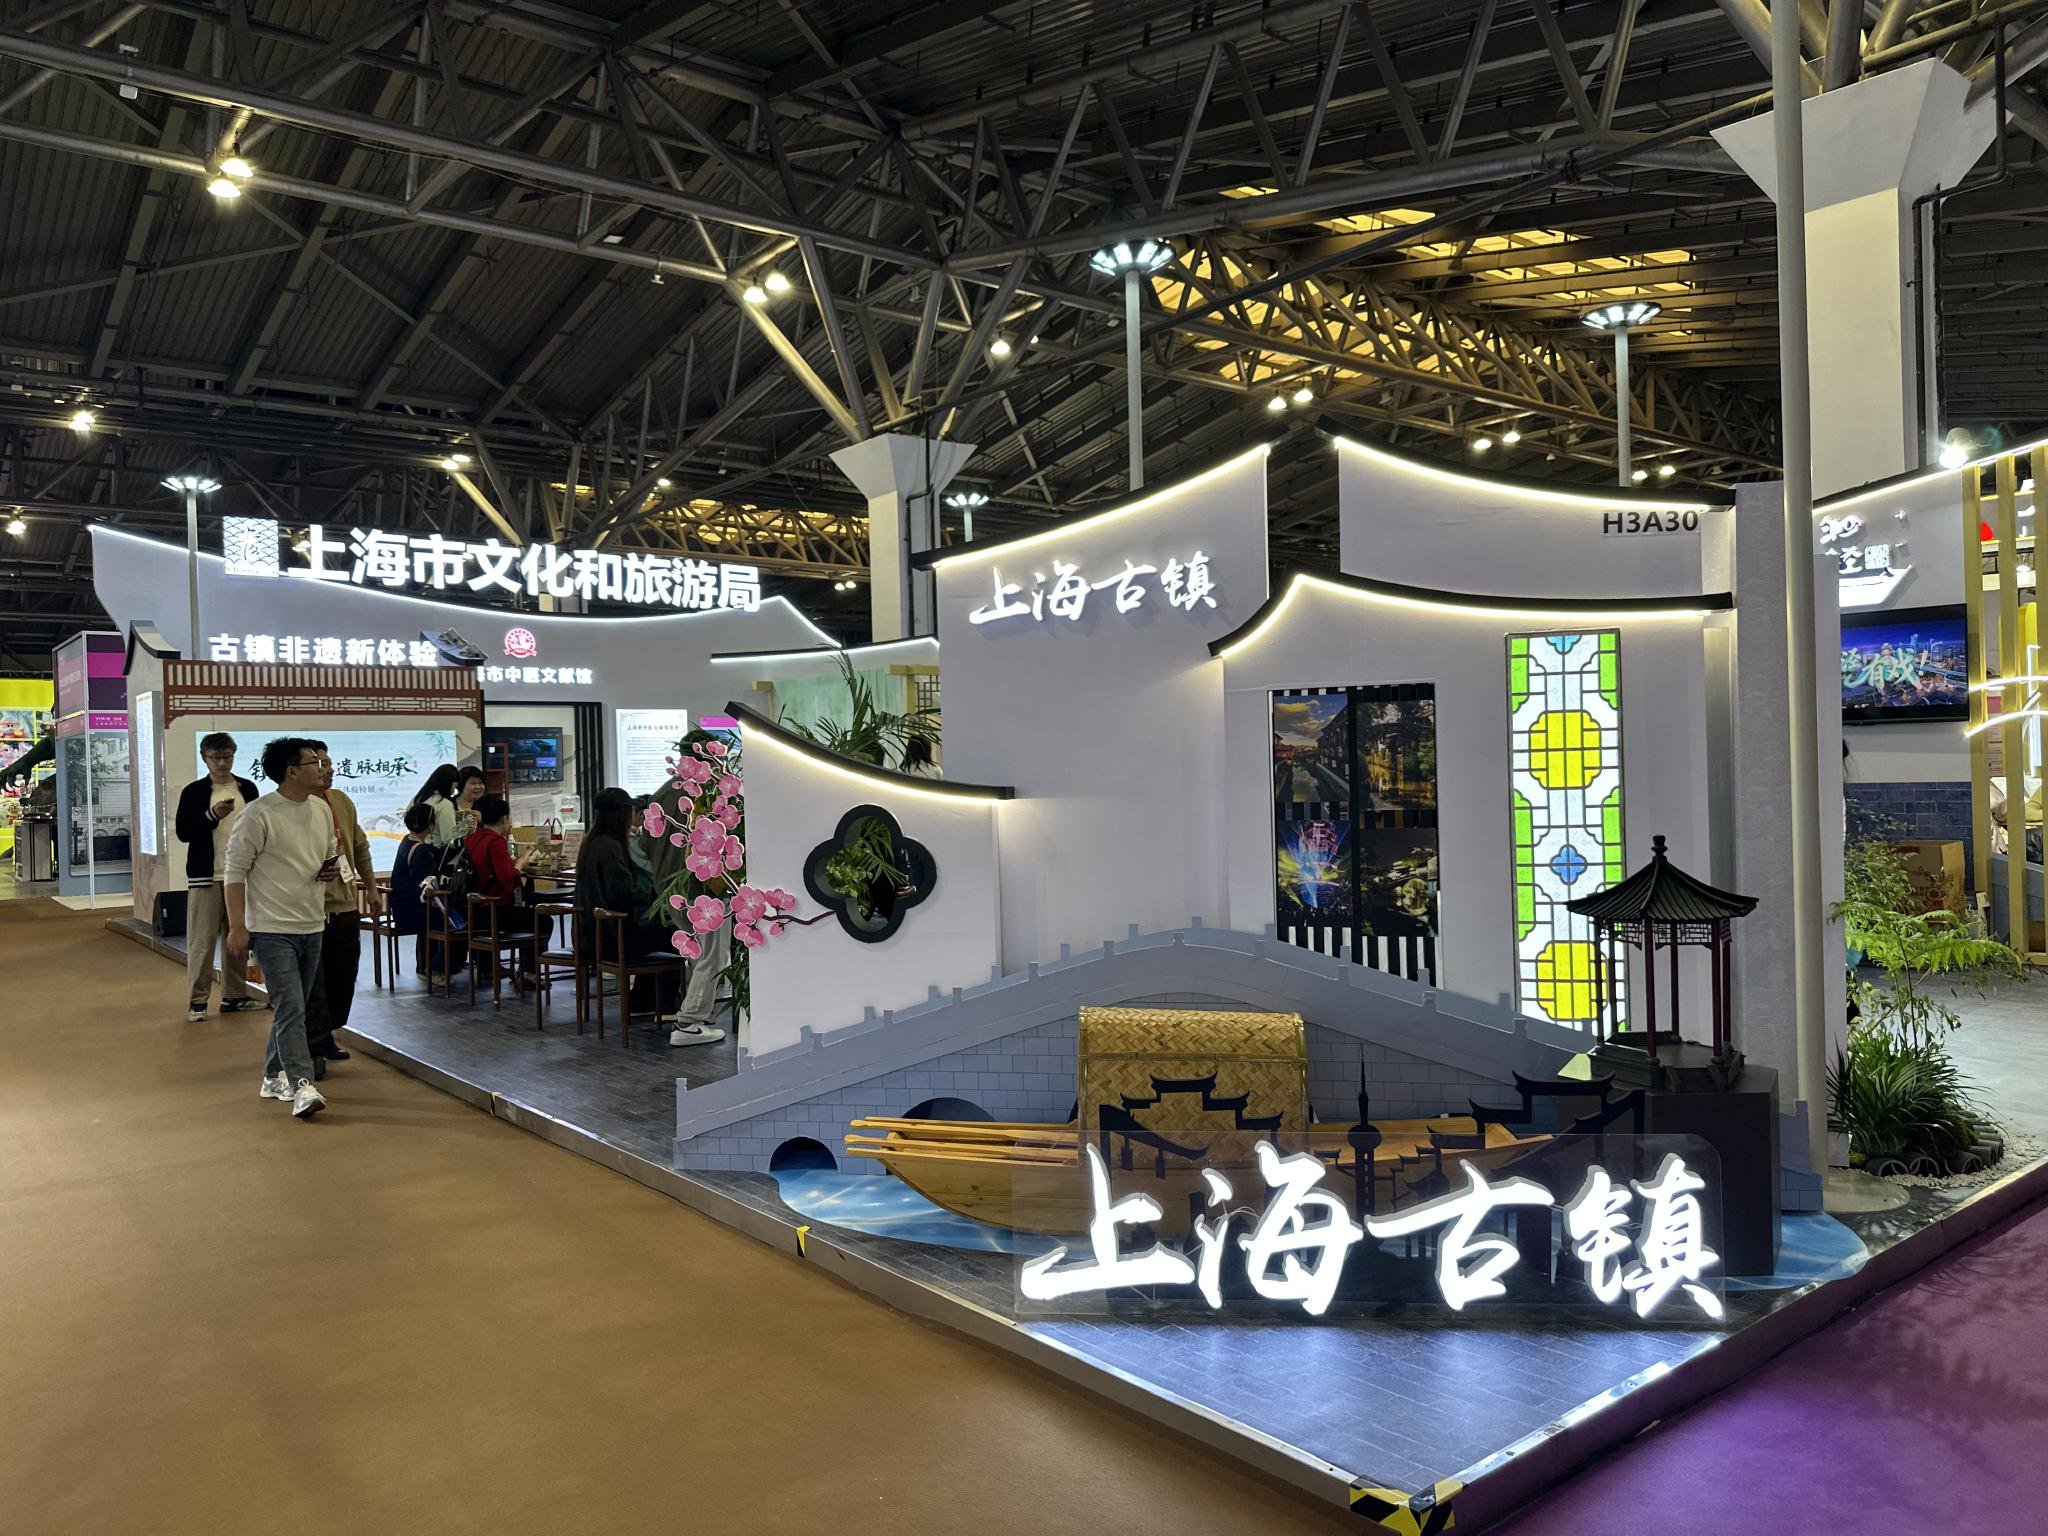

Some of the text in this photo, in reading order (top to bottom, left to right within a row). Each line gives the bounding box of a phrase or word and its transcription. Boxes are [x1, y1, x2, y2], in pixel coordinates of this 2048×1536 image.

[1603, 510, 1697, 534] H3A30
[287, 524, 761, 612] 上海市文化和旅游局
[969, 551, 1218, 624] 上海古镇
[208, 633, 438, 666] 古镇非遗新体验
[1020, 1144, 1724, 1318] 上海古镇
